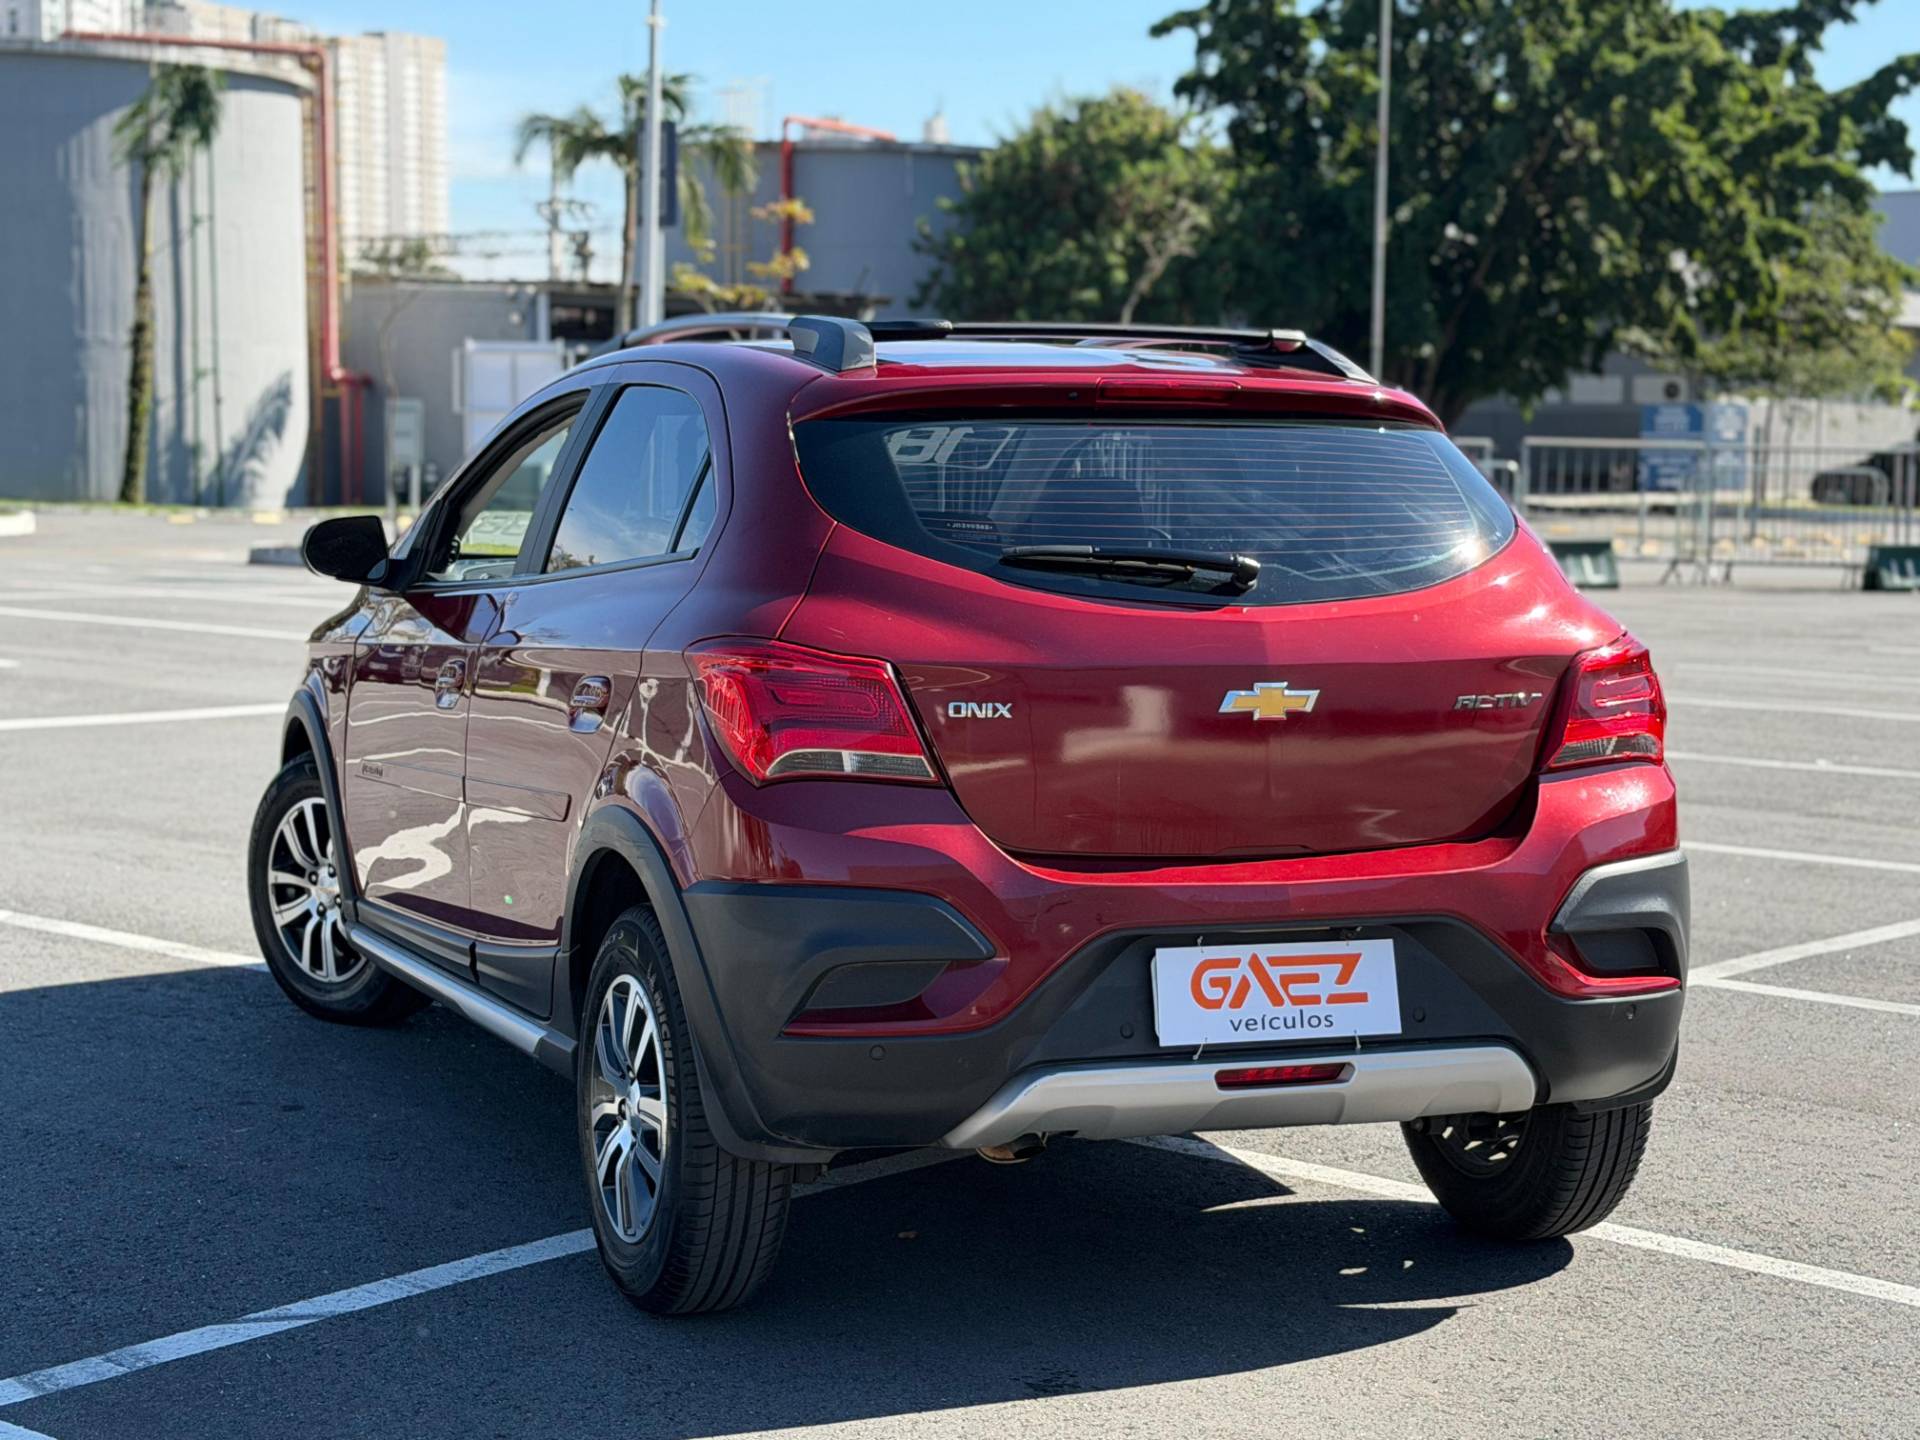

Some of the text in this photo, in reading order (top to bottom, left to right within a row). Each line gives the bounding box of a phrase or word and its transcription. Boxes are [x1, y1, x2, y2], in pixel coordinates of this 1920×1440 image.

[948, 702, 1012, 718] ONIX
[1454, 692, 1543, 710] ACTIV
[1190, 952, 1369, 1010] GAEZ
[1229, 1009, 1335, 1032] veículos
[653, 990, 677, 1129] MICHELIN
